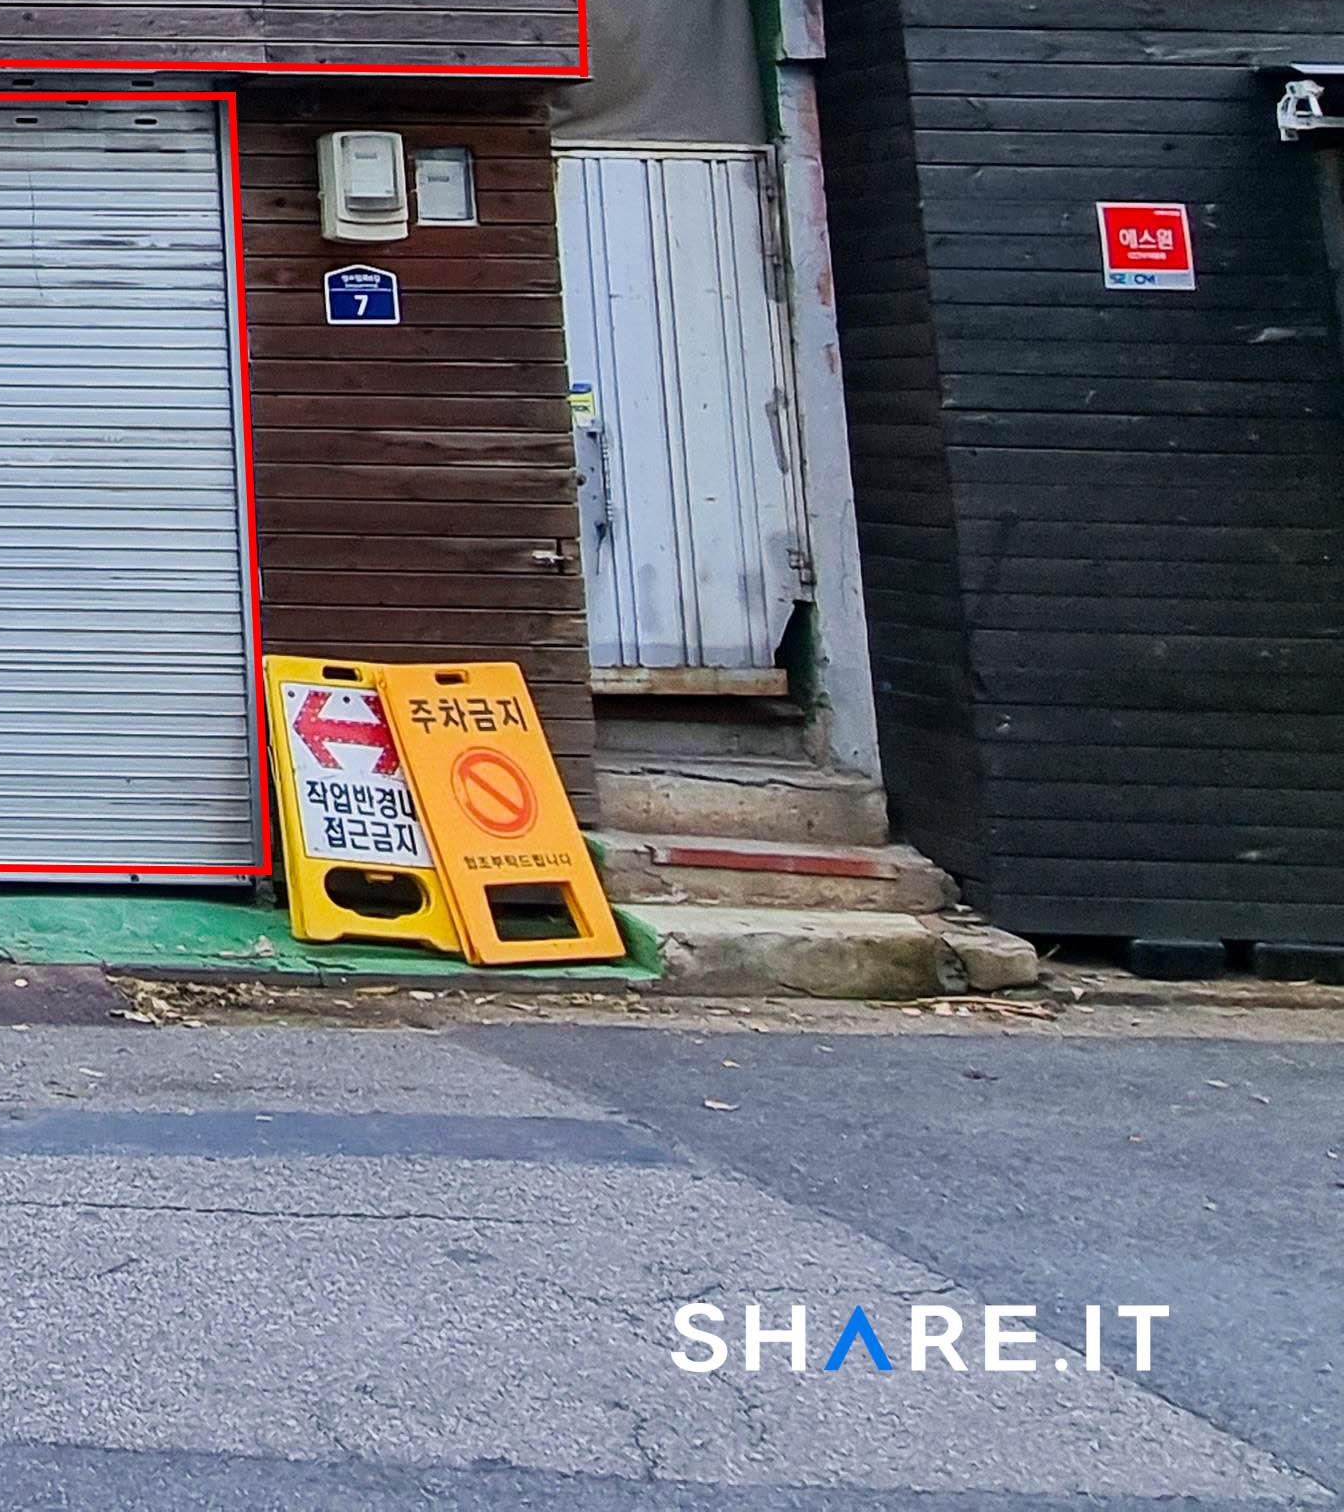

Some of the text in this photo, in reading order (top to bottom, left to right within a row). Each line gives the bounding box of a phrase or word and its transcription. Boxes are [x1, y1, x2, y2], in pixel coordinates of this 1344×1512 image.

[354, 295, 369, 316] 7
[409, 696, 528, 734] 주차금지
[323, 817, 418, 856] 접근금지
